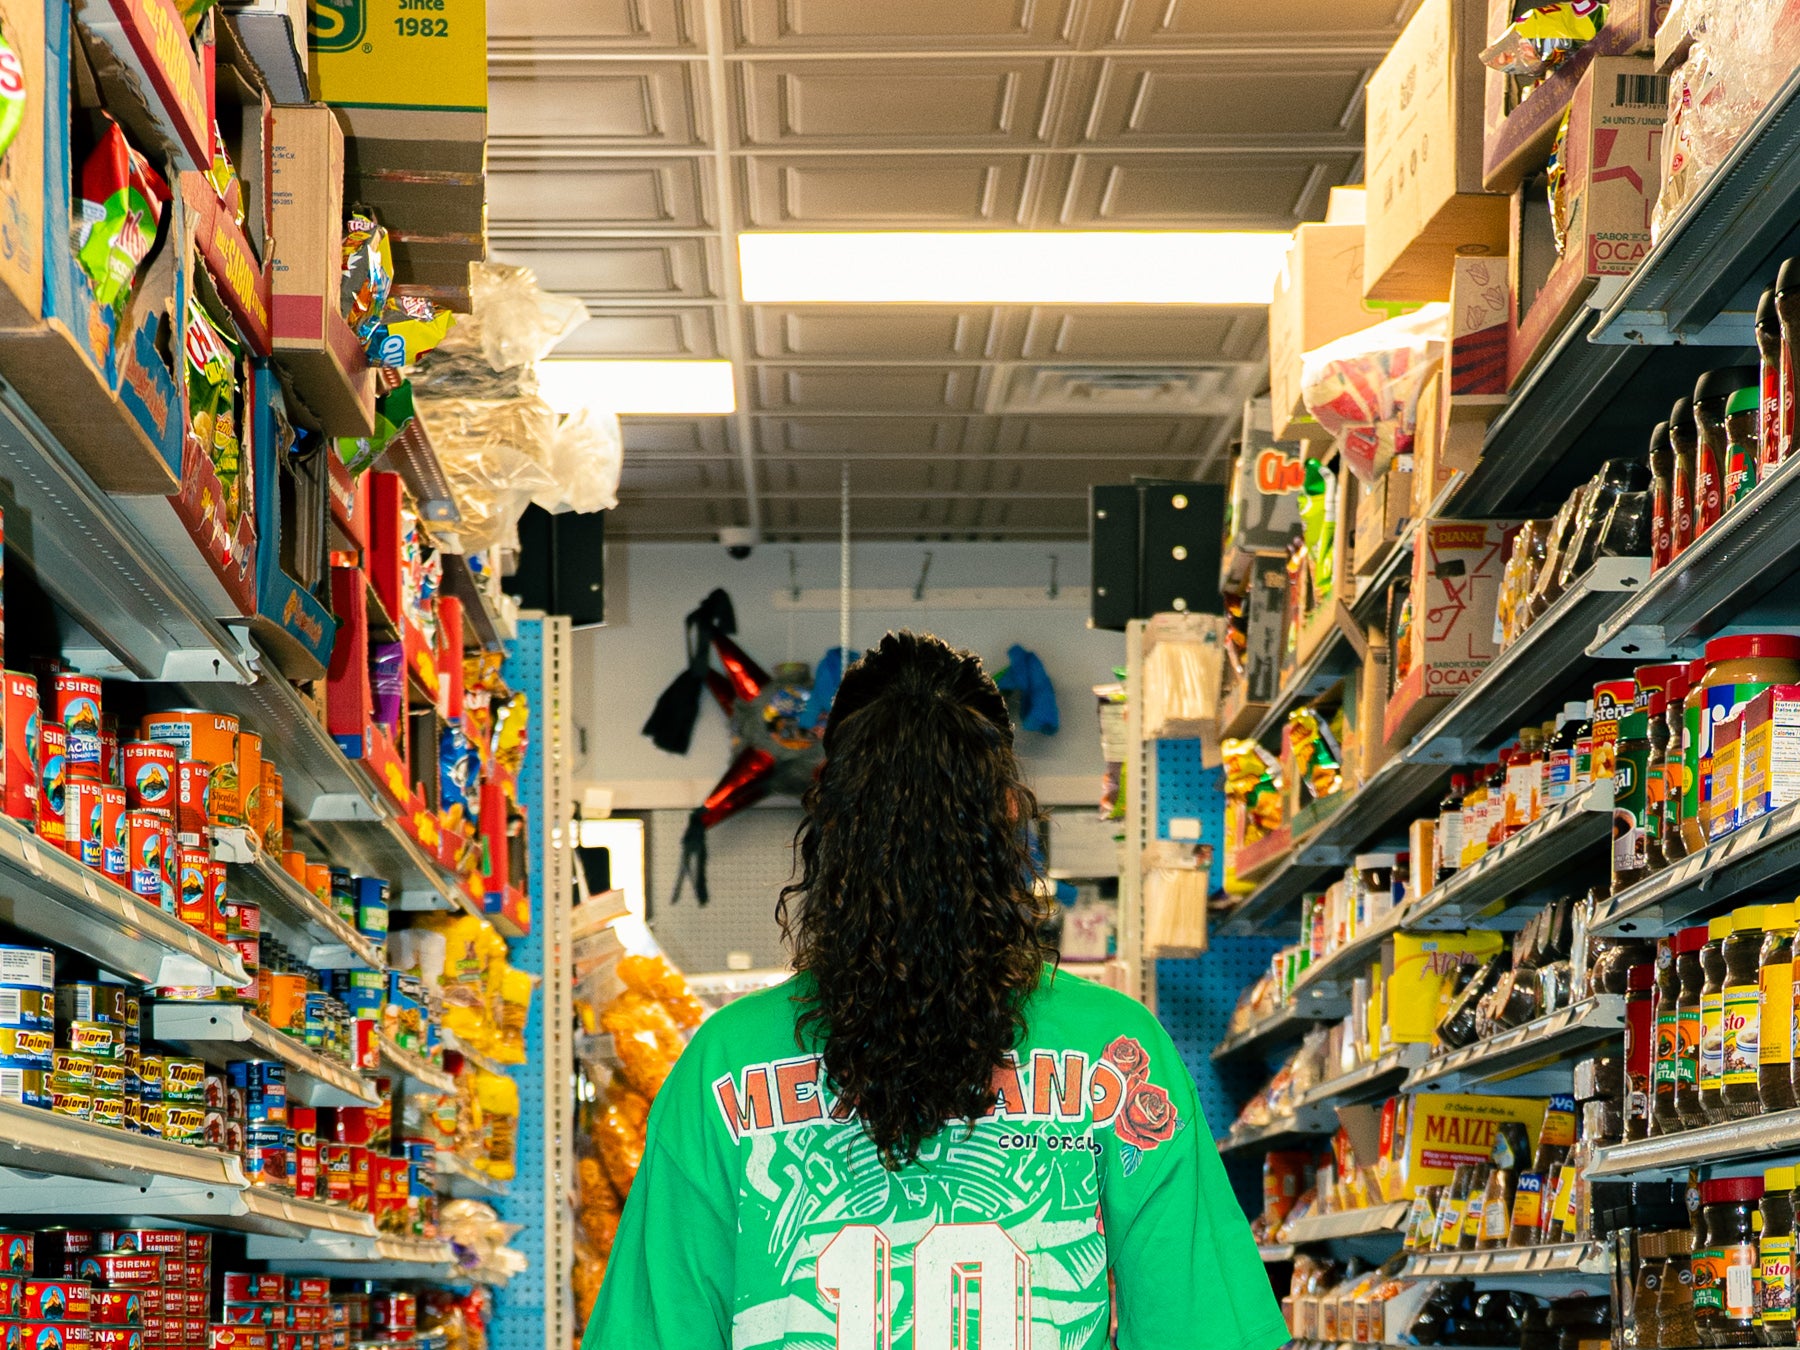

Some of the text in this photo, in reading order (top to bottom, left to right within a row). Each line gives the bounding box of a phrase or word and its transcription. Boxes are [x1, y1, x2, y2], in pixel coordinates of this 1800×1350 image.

[394, 18, 449, 38] 1982
[1614, 116, 1634, 125] UNITS
[1438, 532, 1480, 544] DIANA
[1598, 696, 1610, 706] La
[136, 748, 175, 759] SIRENA
[711, 1048, 1127, 1146] MEANO
[1424, 1115, 1498, 1148] MAIZE
[155, 1234, 181, 1243] SIRENA
[116, 1260, 150, 1268] SIRENA
